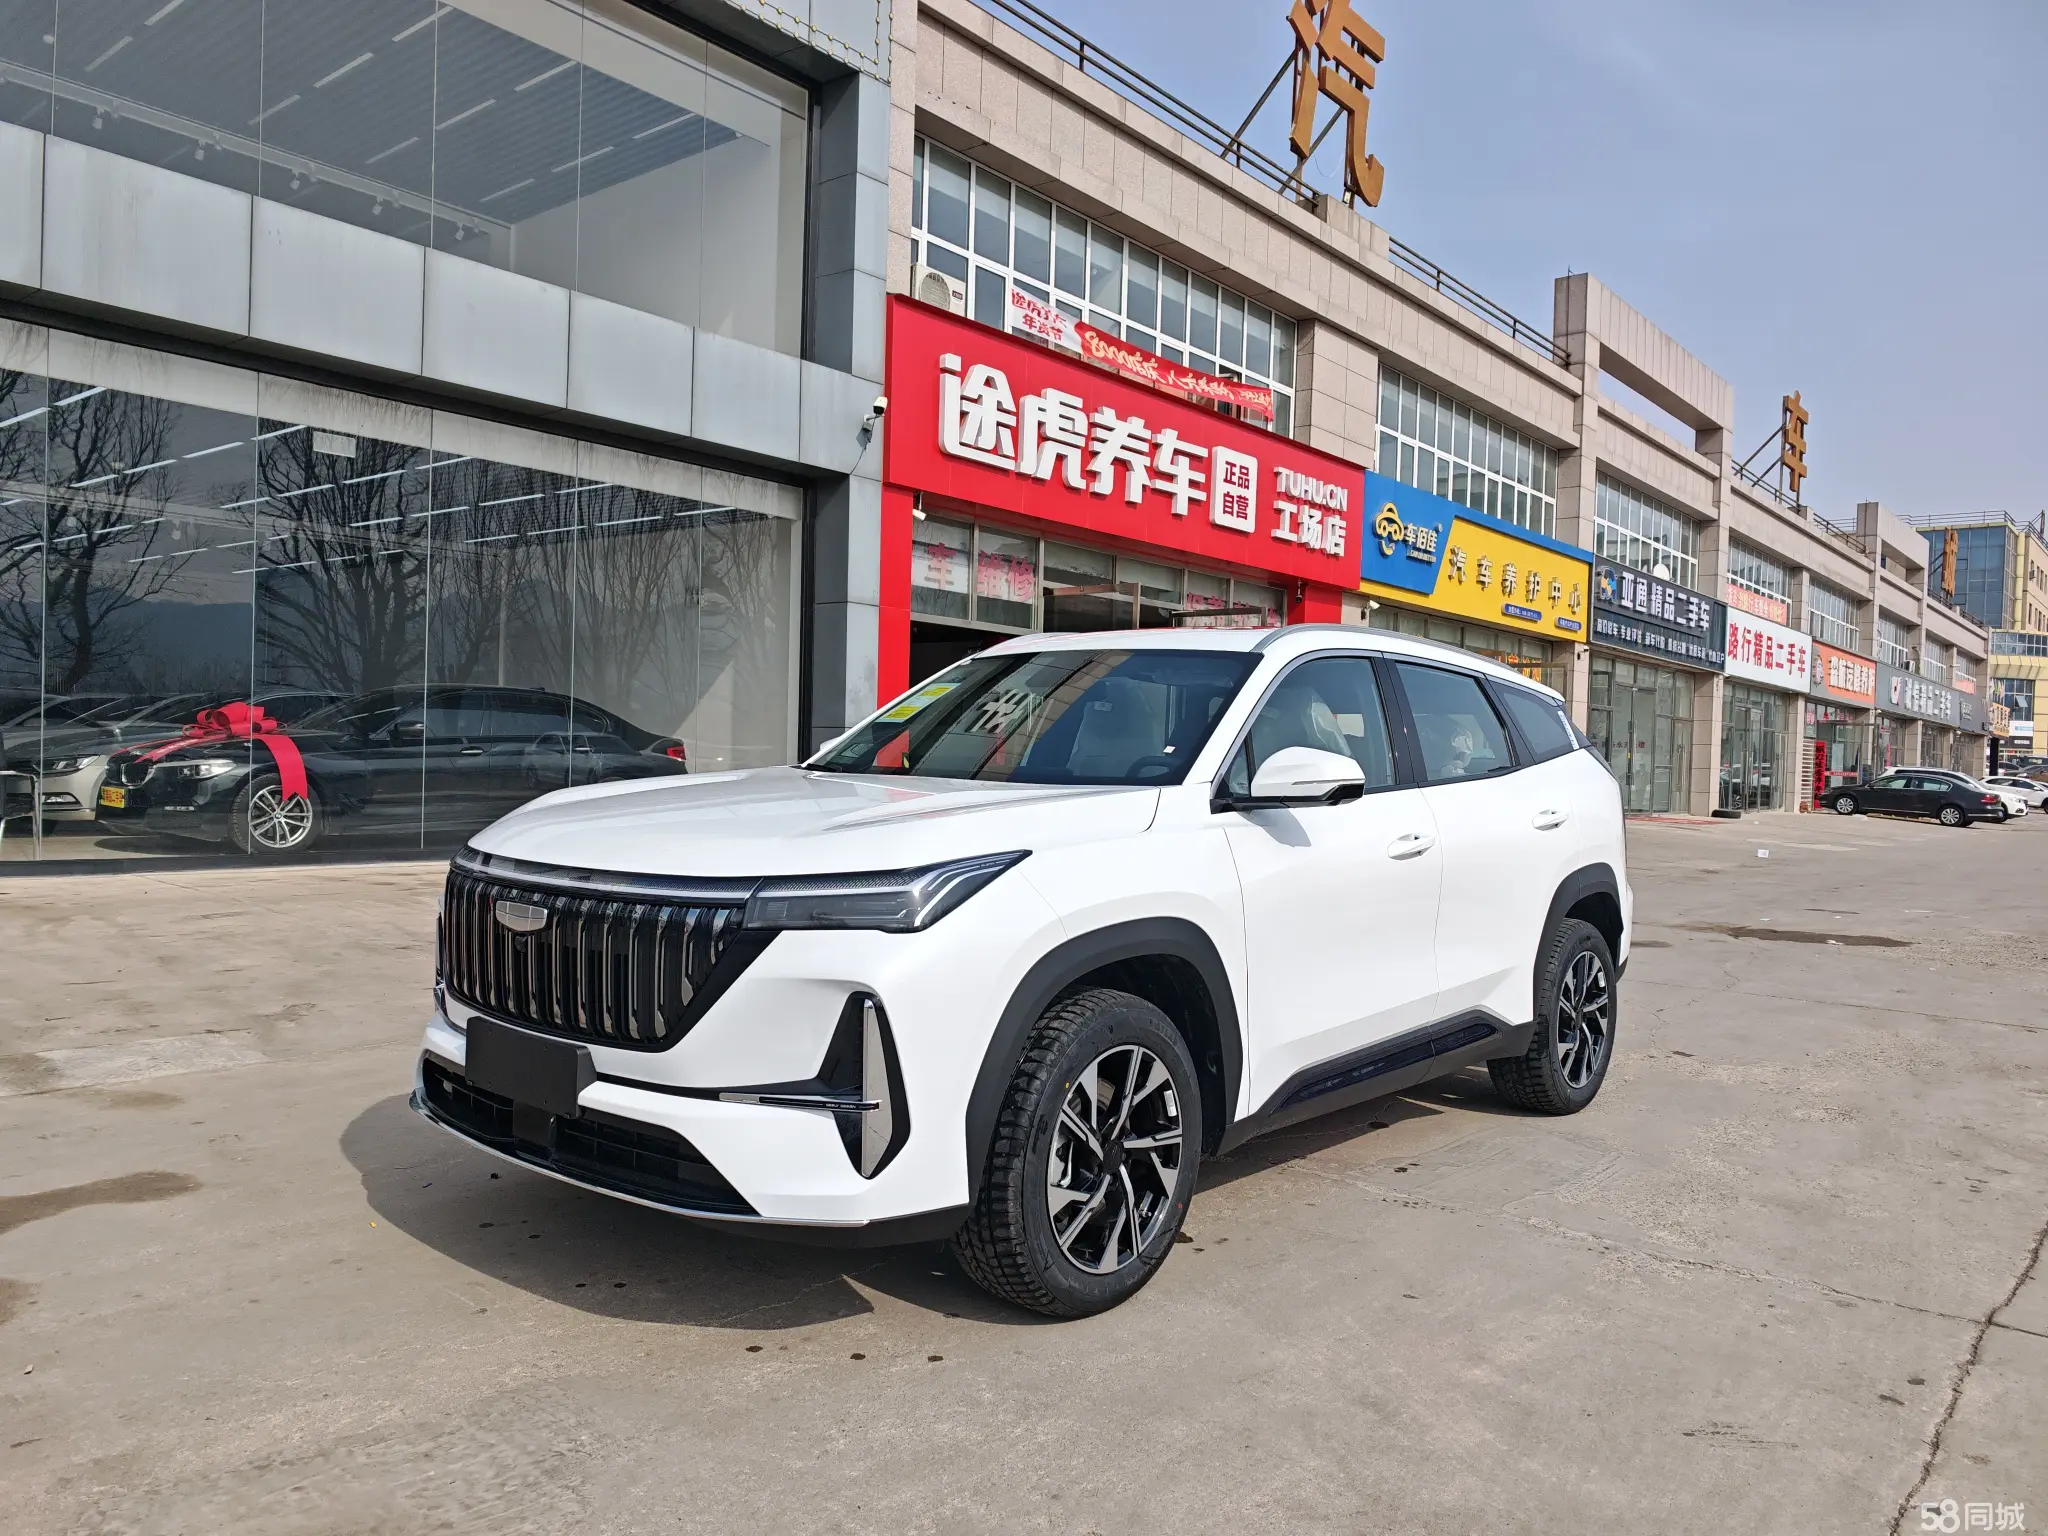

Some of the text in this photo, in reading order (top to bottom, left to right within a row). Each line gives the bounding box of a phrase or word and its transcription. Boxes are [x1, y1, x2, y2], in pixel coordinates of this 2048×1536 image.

[1287, 0, 1386, 207] 汽
[938, 352, 1209, 516] 途虎养车
[1783, 389, 1809, 492] 车
[1223, 460, 1250, 491] 正品
[1273, 466, 1348, 512] TUHU.CN
[1222, 491, 1249, 521] 自营
[1271, 500, 1347, 557] 工场店
[1448, 545, 1582, 615] 汽车养护中心
[1620, 571, 1710, 632] 亚通精品二手车
[1728, 622, 1807, 679] 路行精品二手车
